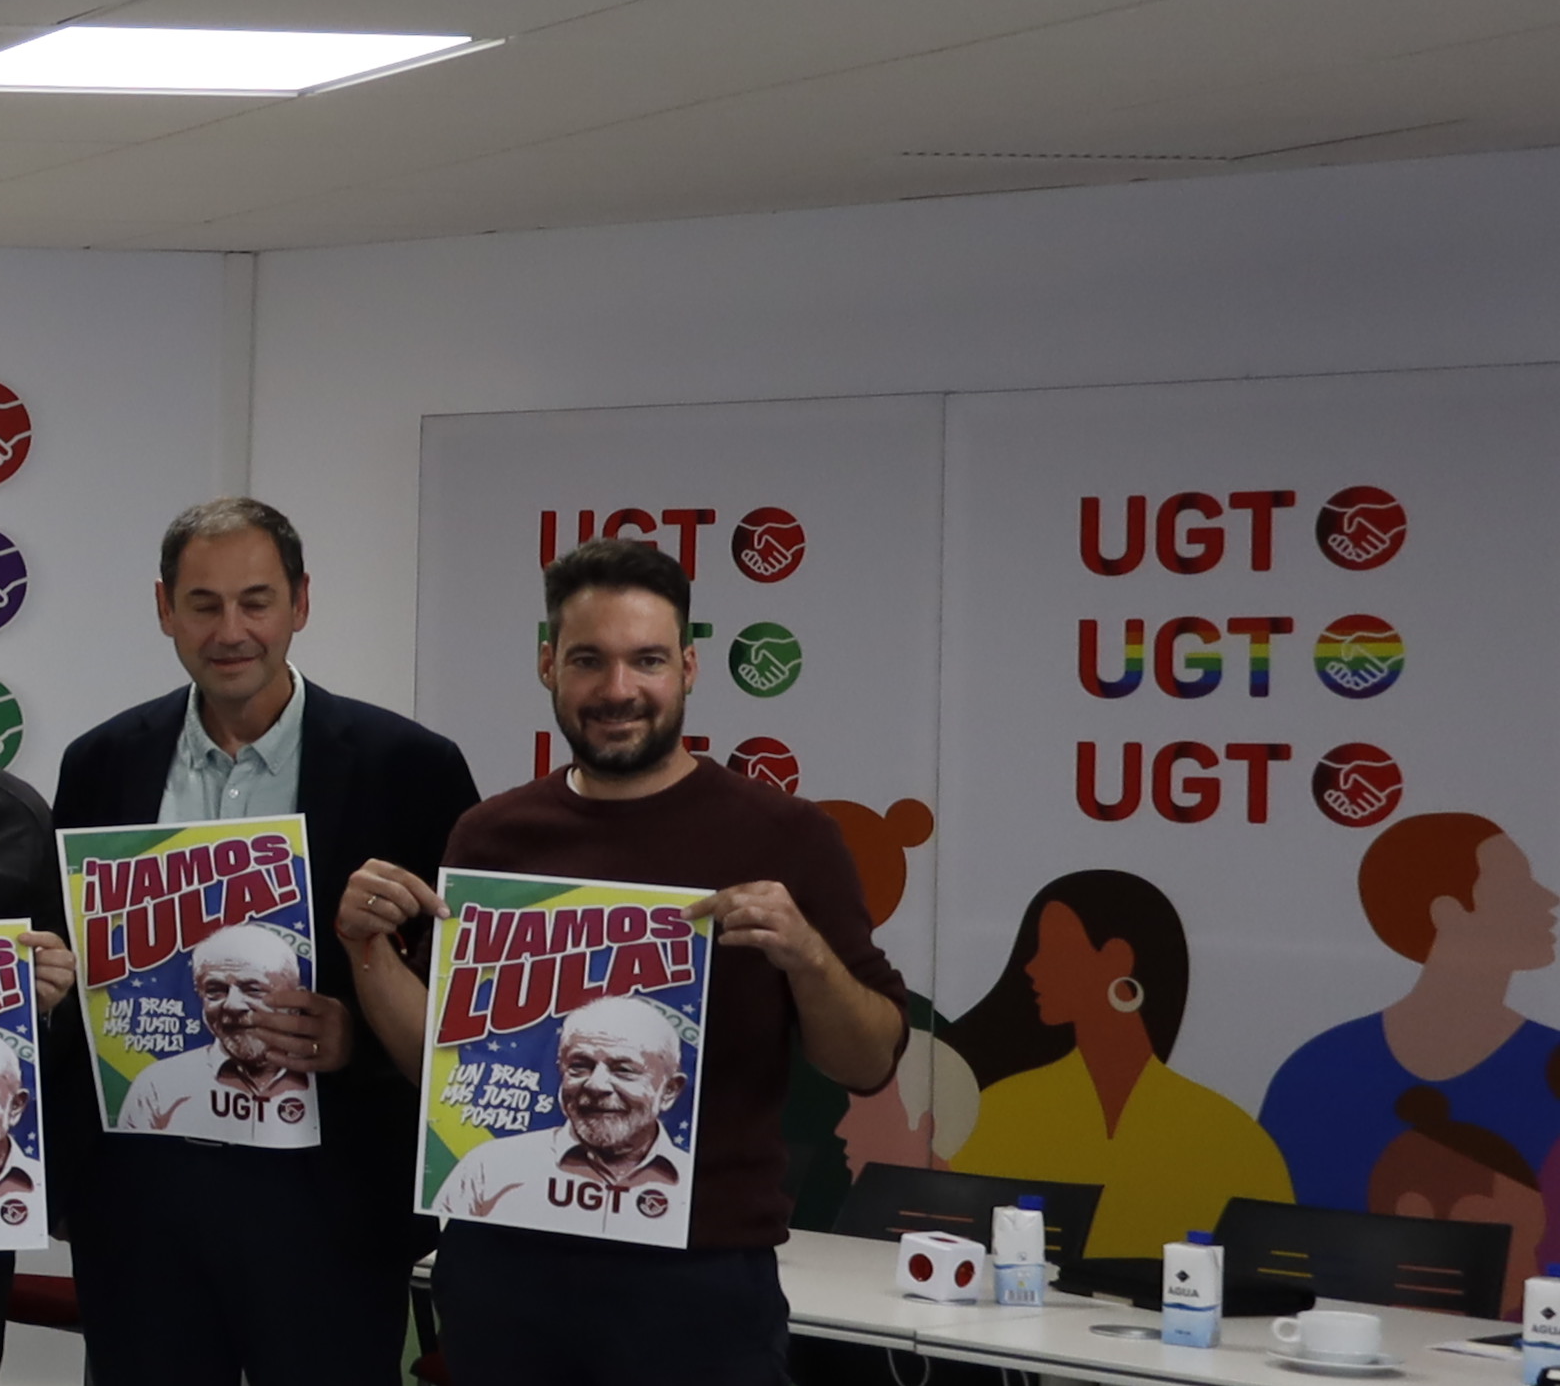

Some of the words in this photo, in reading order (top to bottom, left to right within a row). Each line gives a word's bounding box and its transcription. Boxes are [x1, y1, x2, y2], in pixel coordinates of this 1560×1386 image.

[1080, 490, 1296, 576] UGT
[1078, 616, 1294, 699] UGT
[1076, 741, 1292, 824] UGT
[84, 836, 291, 913] ¡VAMOS
[84, 866, 298, 990] LULA!
[451, 904, 693, 965] ¡VAMOS
[435, 941, 695, 1045] LULA!
[210, 1090, 271, 1123] UGT
[477, 1084, 531, 1110] JUSTO
[488, 1063, 540, 1092] BRASIL
[547, 1177, 630, 1214] UGT
[1168, 1286, 1200, 1298] AGUA
